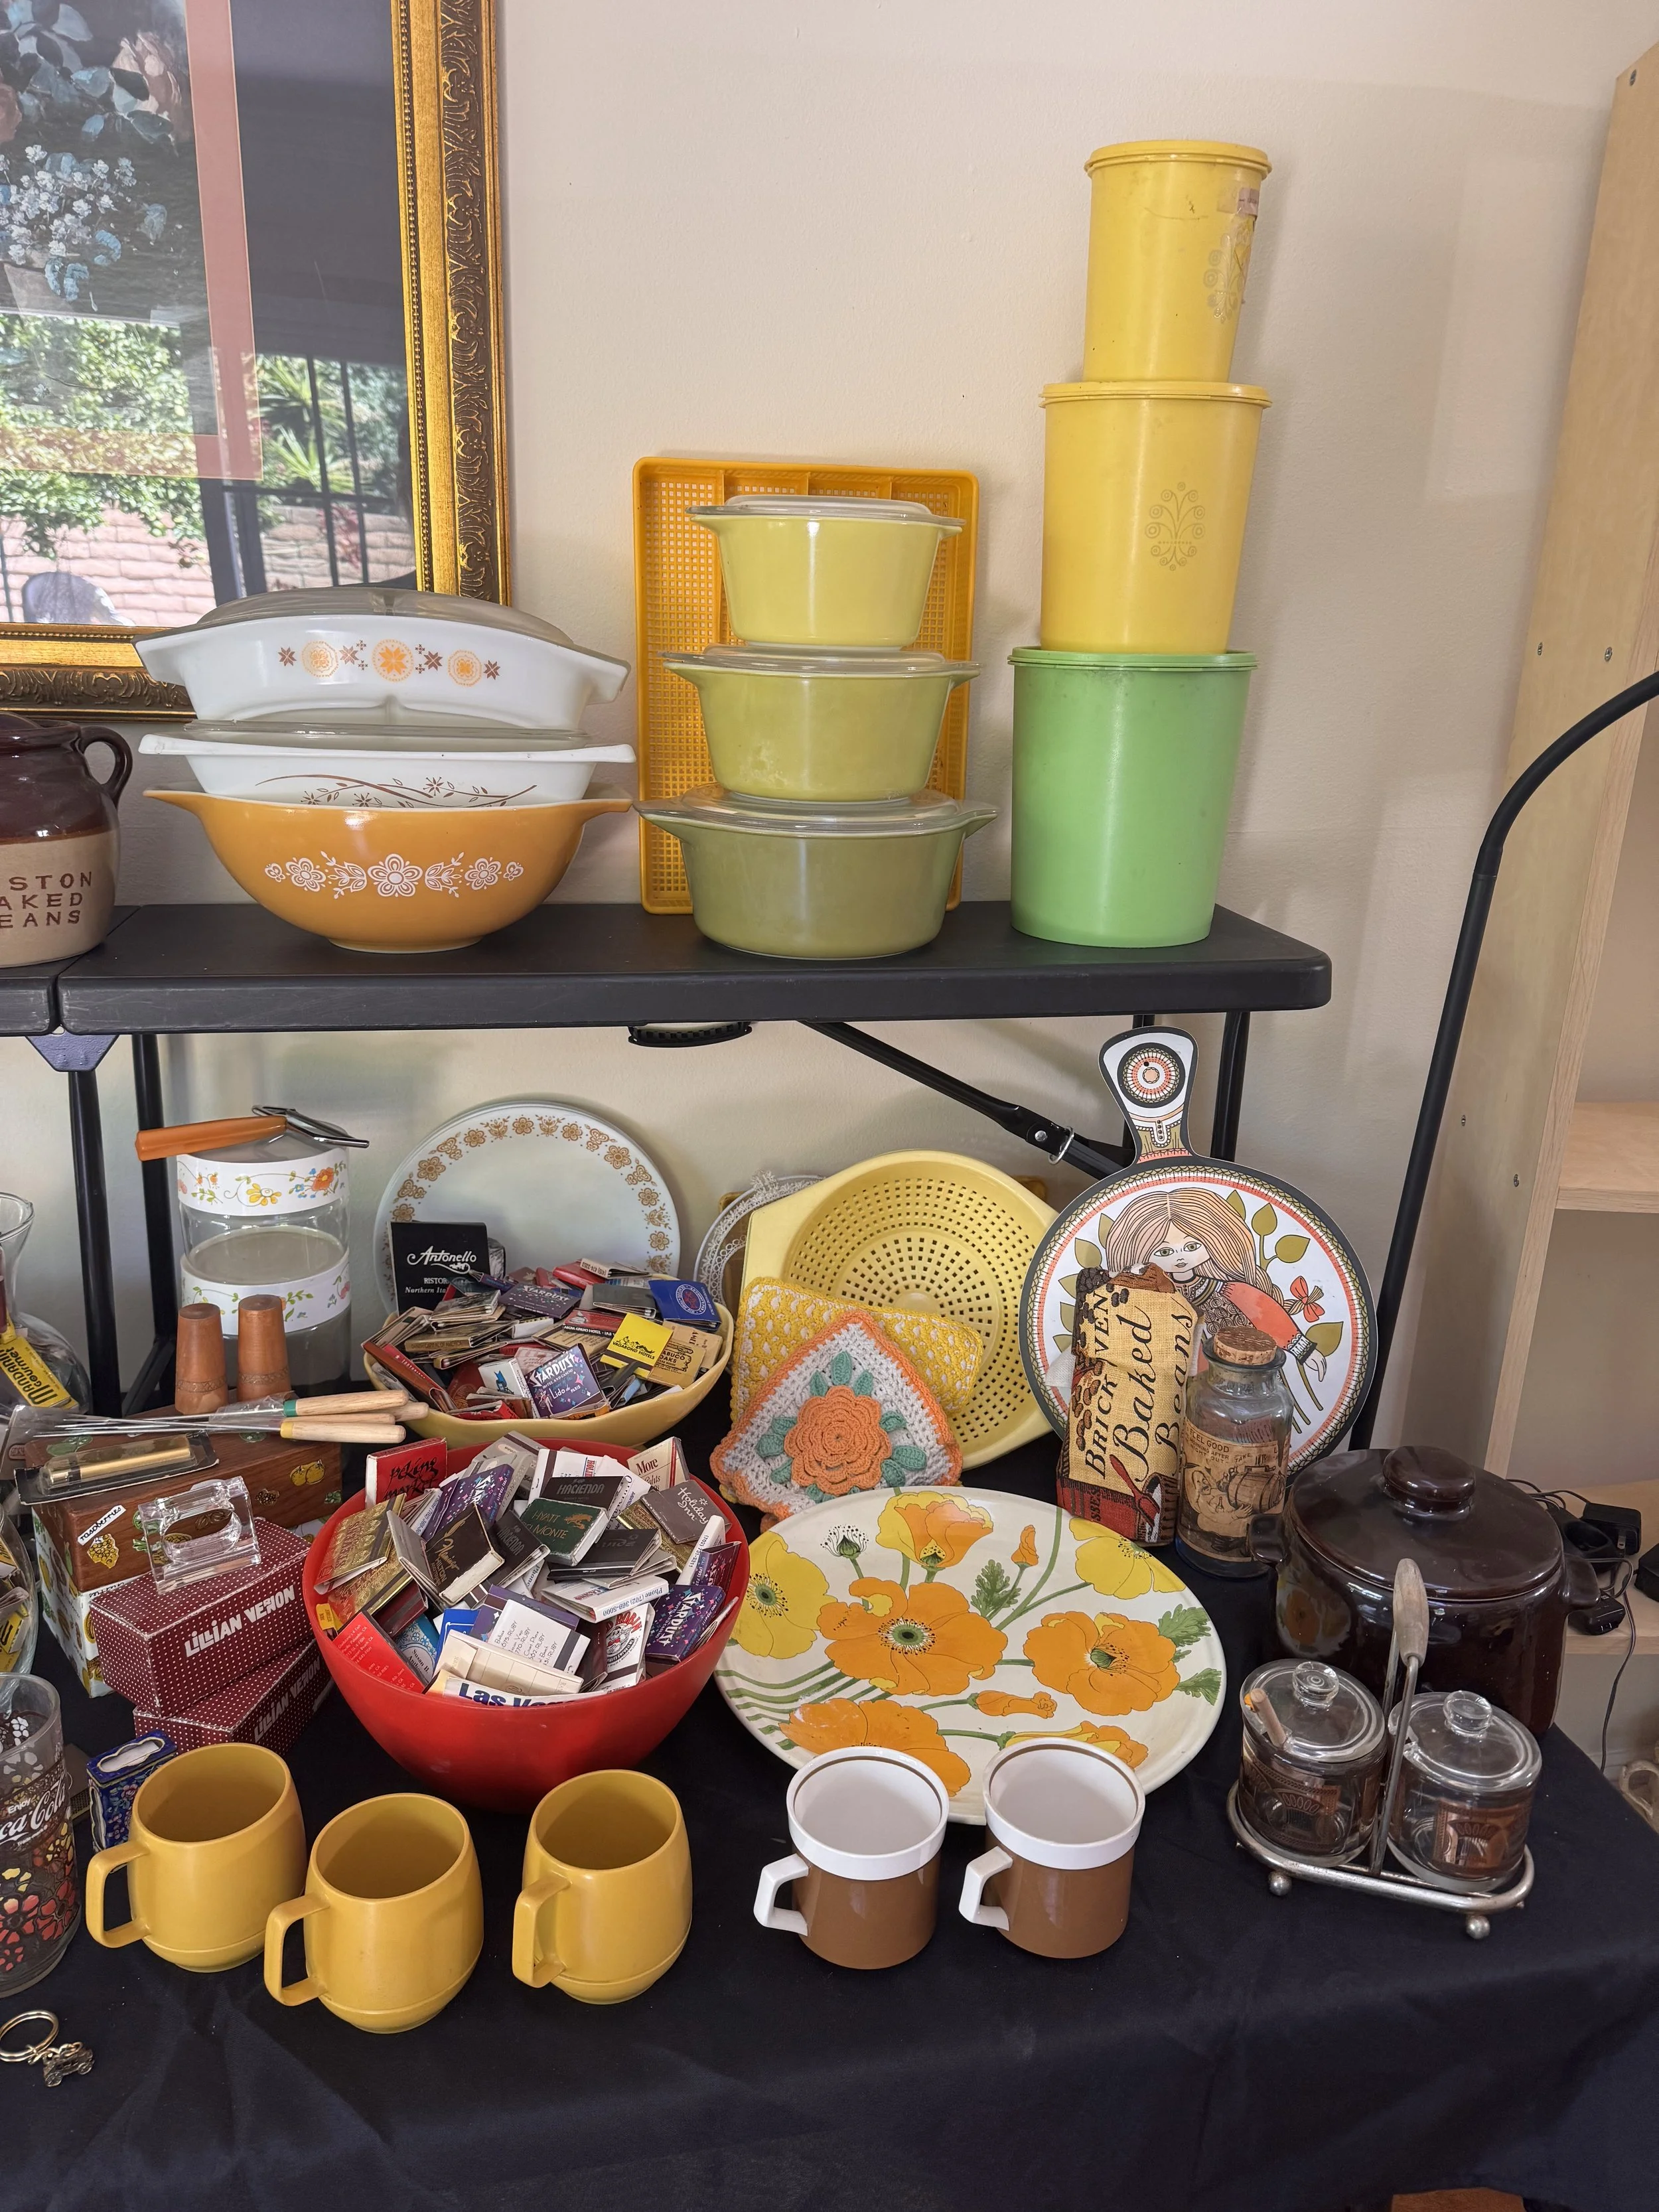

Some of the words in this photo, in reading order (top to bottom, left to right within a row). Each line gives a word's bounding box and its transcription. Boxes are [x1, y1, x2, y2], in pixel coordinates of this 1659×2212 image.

[9, 871, 92, 891] STON
[0, 892, 83, 911] AKED
[0, 910, 81, 928] EANS
[407, 1245, 476, 1266] Antonello
[520, 1285, 571, 1301] STARDUST
[613, 1341, 638, 1353] VAGABOND
[638, 1350, 655, 1360] HOTELS
[530, 1353, 575, 1388] STARDUST
[549, 1388, 565, 1399] Lido
[571, 1384, 581, 1394] PARIS
[1113, 1305, 1157, 1482] Baked
[1155, 1296, 1194, 1477] Beans
[1085, 1374, 1118, 1480] BRICK
[1190, 1444, 1207, 1457] NIGHT
[1235, 1453, 1252, 1463] TAKE
[1206, 1440, 1230, 1453] GOOD
[1211, 1451, 1230, 1460] AFTER
[636, 1458, 658, 1476] More
[557, 1483, 605, 1495] HACIENDA
[677, 1487, 708, 1524] Holiday
[677, 1501, 695, 1521] Inn
[532, 1510, 561, 1523] HYATT
[532, 1524, 569, 1539] MONTE
[699, 1535, 709, 1547] (702)
[435, 1538, 460, 1571] Flamingo
[435, 1557, 447, 1583] HILTON
[527, 1565, 540, 1587] Phone
[630, 1594, 645, 1605] (702)
[644, 1587, 663, 1598] Phone
[244, 1584, 295, 1623] VERNON
[603, 1601, 630, 1617] 369-5000
[615, 1611, 642, 1633] ROBIN
[658, 1591, 703, 1647] STARDUST
[514, 1627, 531, 1655] 770-RUBY
[411, 1649, 423, 1667] Susan
[423, 1666, 429, 1674] B.
[289, 1656, 321, 1699] VERNON
[459, 1682, 506, 1707] Las
[7, 1797, 31, 1814] Enjoy
